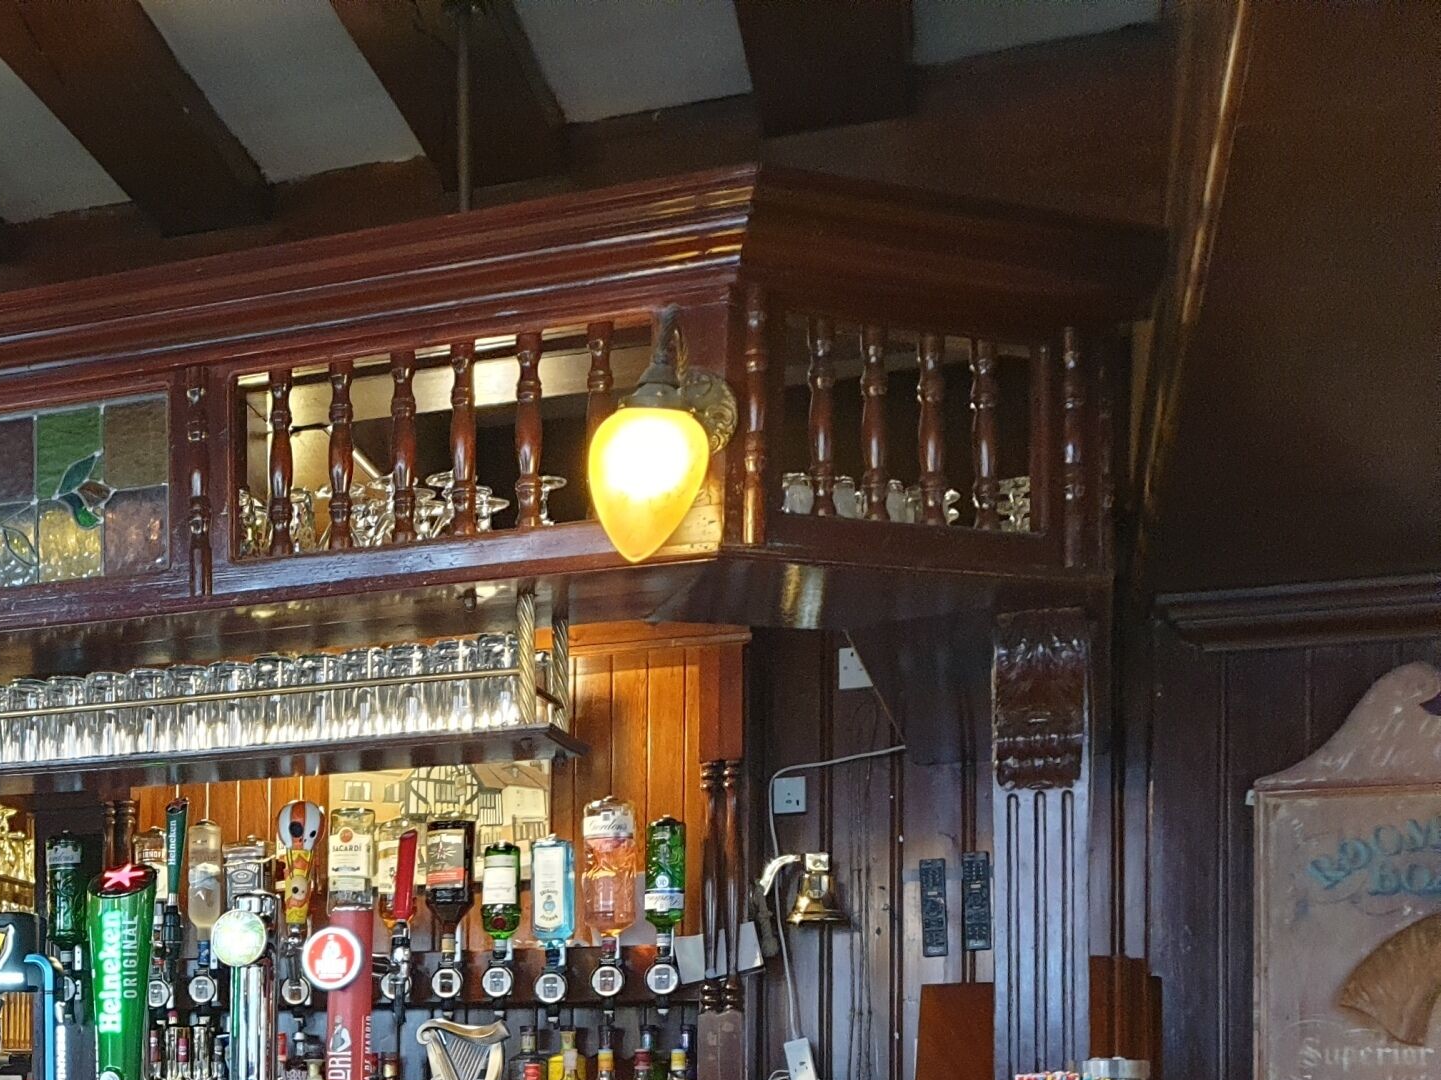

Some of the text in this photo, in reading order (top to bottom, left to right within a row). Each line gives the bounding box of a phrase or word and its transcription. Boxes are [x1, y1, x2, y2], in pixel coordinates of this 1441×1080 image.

[167, 819, 177, 866] Heineken
[98, 909, 121, 1034] Heineken
[122, 911, 138, 999] ORIGINAL
